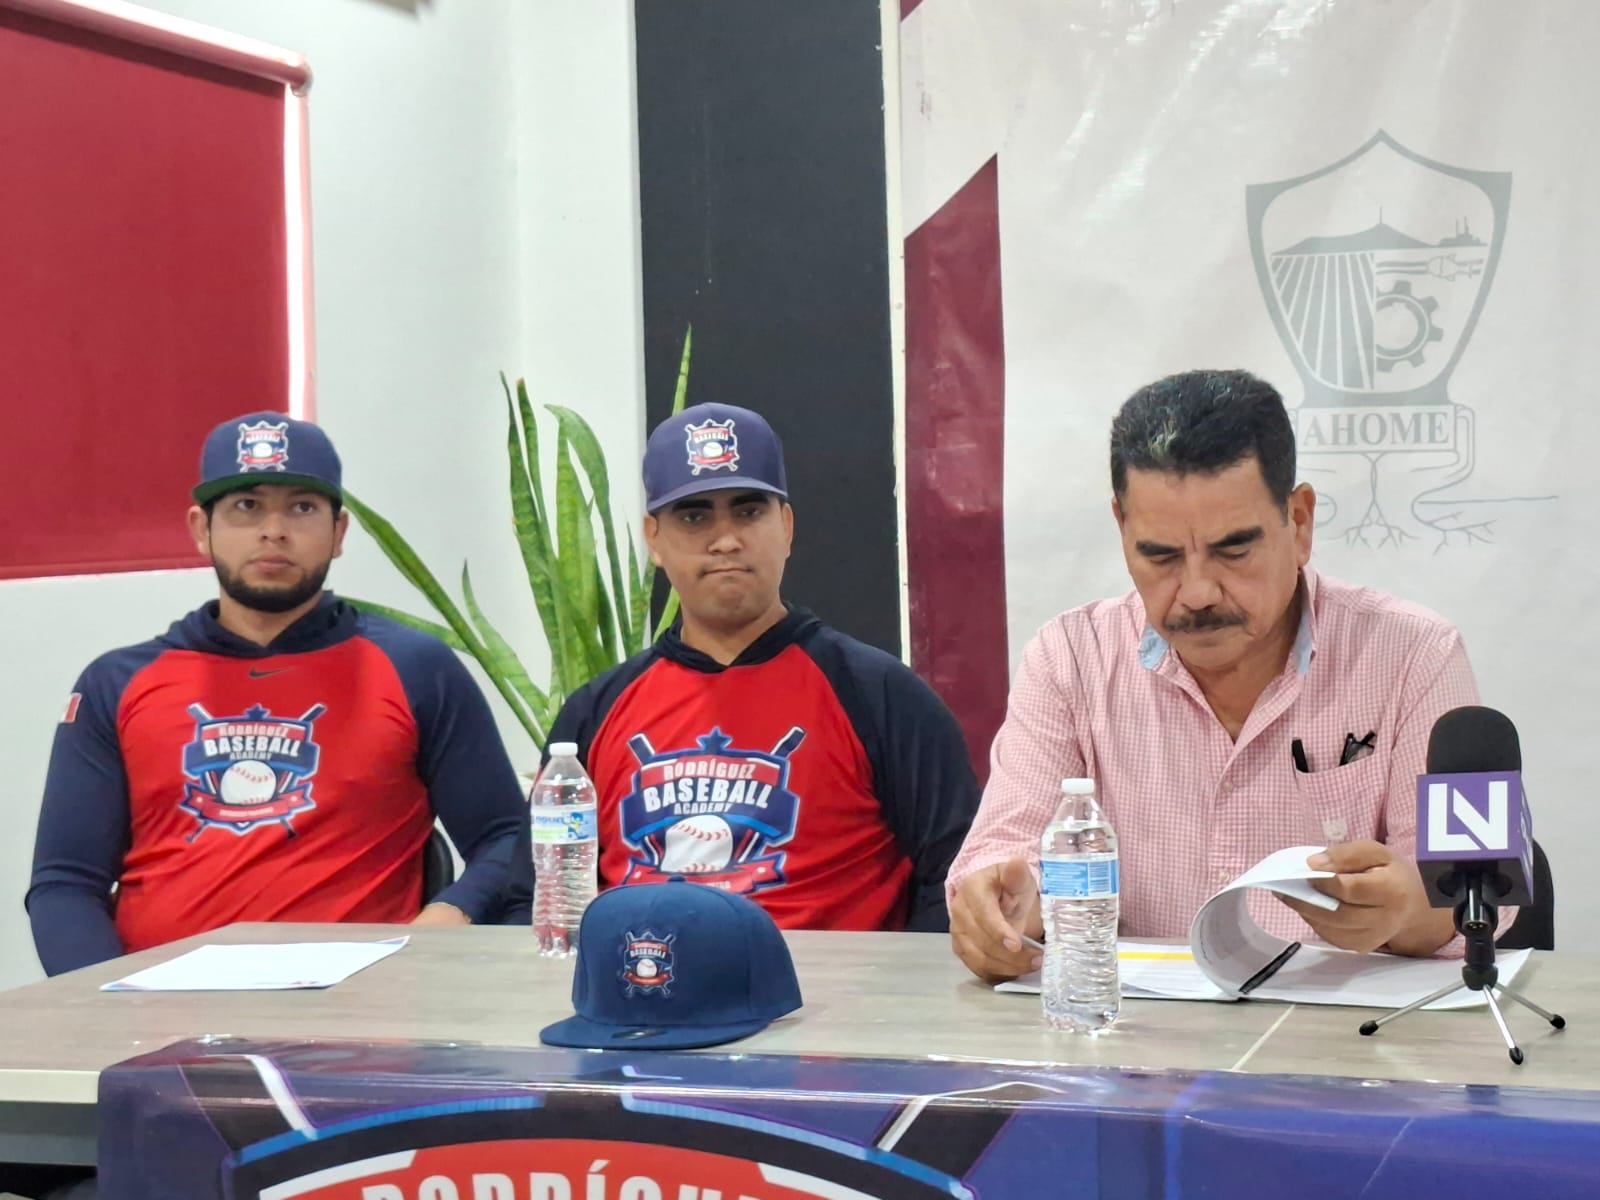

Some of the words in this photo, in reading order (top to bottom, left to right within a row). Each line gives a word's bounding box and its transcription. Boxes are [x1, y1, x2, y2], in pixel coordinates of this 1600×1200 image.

[1303, 412, 1449, 446] AHOME
[204, 735, 301, 757] BASEBALL
[663, 758, 756, 781] RODRÍGUEZ
[643, 777, 773, 813] BASEBALL
[673, 803, 733, 815] ACADEMY
[1428, 780, 1508, 852] LN
